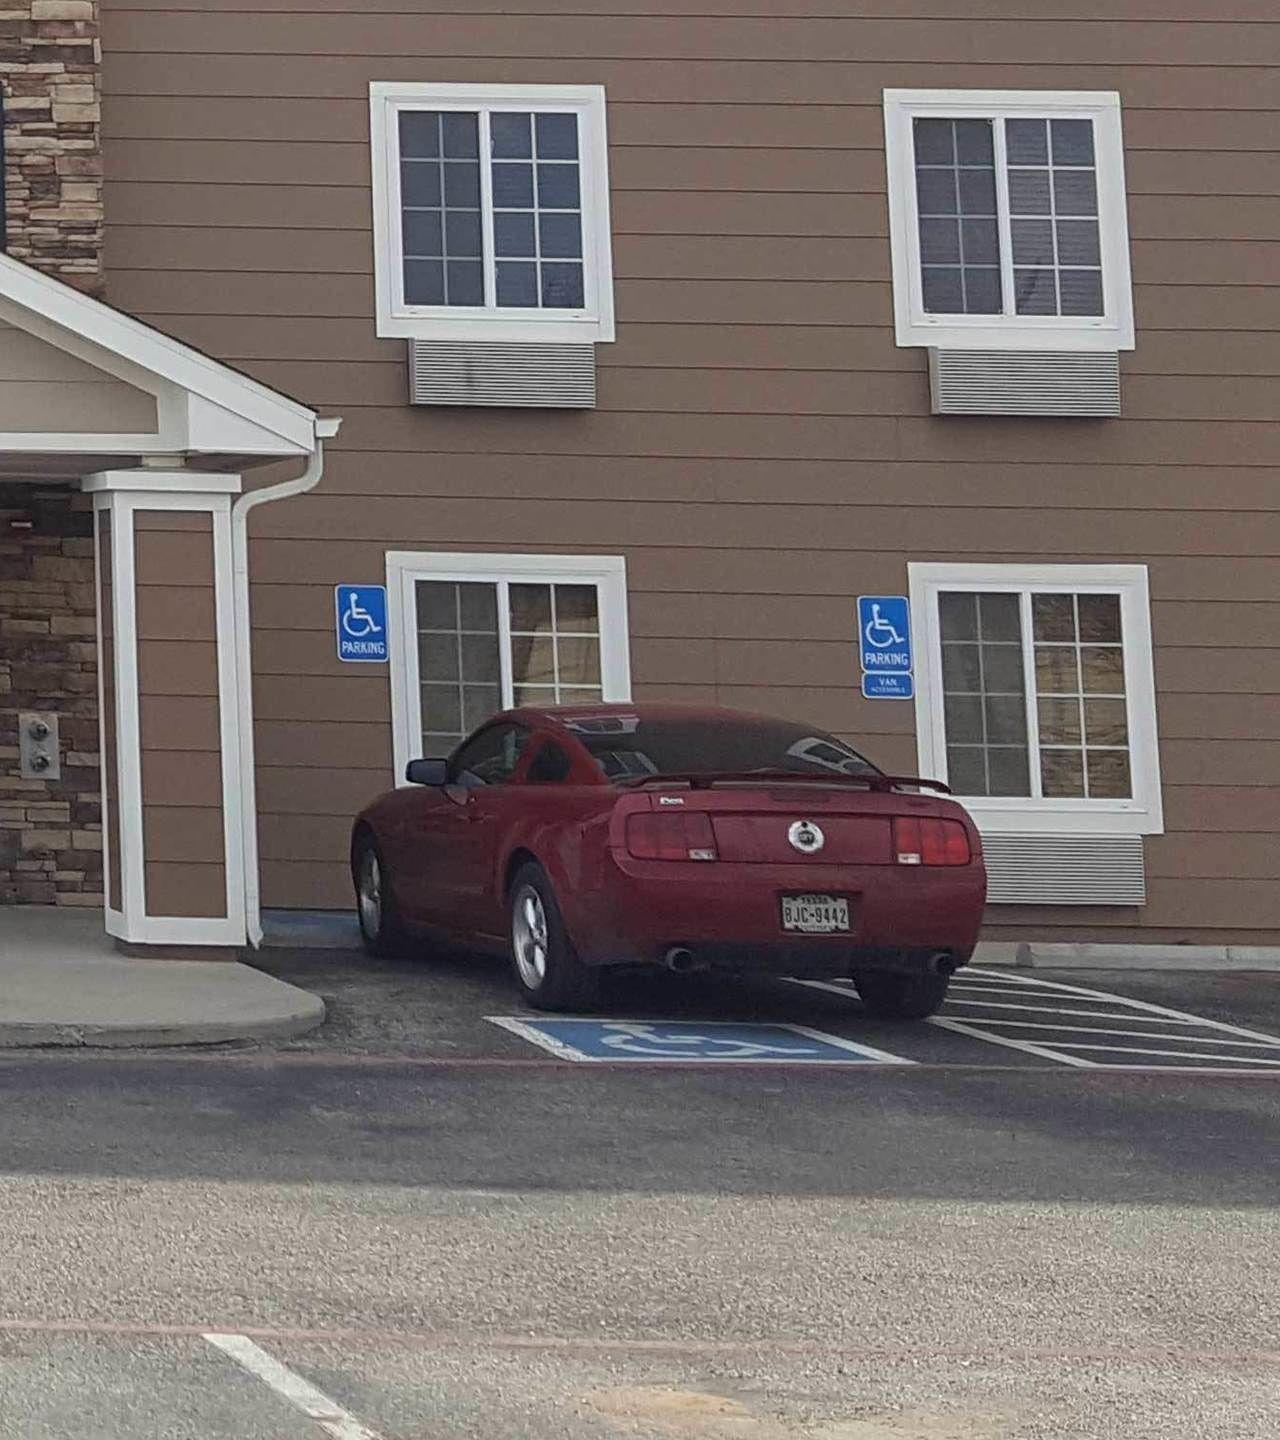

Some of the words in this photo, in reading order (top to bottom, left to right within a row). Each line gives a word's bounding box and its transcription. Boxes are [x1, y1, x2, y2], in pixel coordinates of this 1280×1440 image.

[342, 641, 385, 654] PARKING
[865, 653, 909, 665] PARKING
[879, 678, 897, 686] VAN
